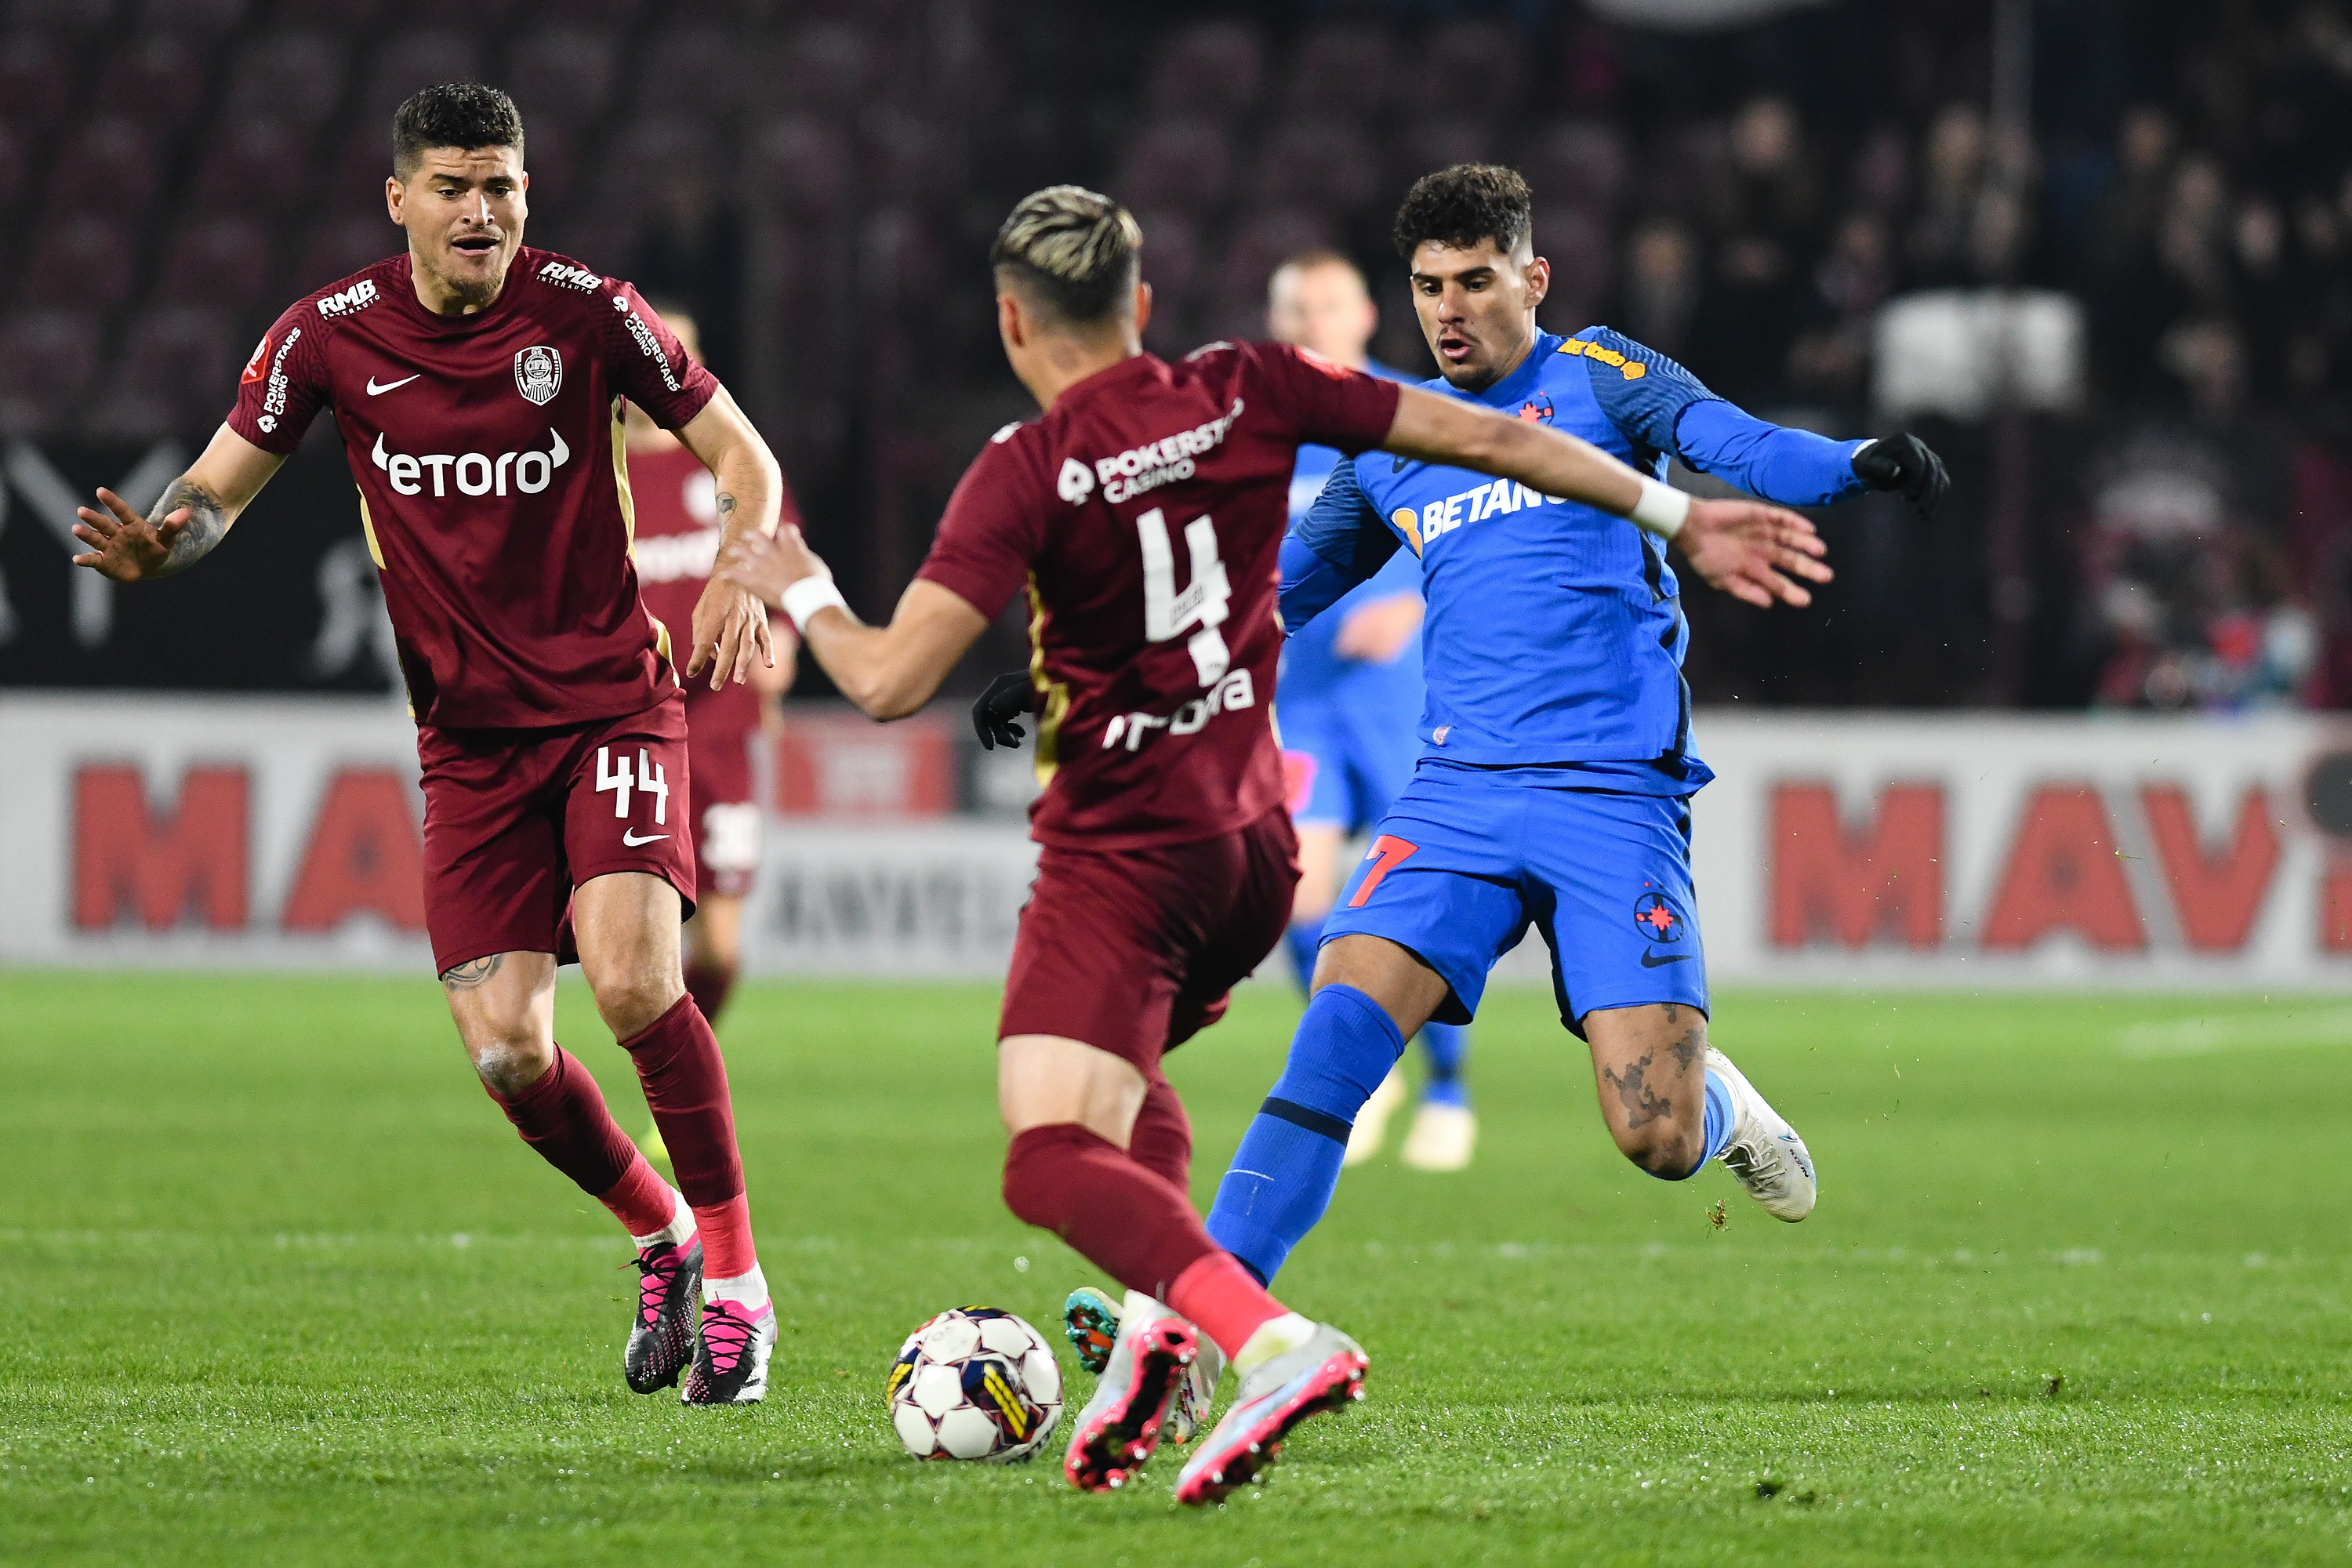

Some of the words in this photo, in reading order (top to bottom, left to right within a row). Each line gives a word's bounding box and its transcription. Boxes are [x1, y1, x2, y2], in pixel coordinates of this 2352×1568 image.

[317, 279, 376, 315] RMB
[536, 274, 593, 295] INTERAUTO
[539, 261, 603, 289] RMB
[624, 318, 652, 357] CASINO
[629, 311, 681, 392] POKERSTARS
[263, 326, 302, 412] POKERSTARS
[274, 375, 289, 416] CASNO
[1136, 506, 1232, 688] 4
[596, 746, 669, 826] 44
[1348, 834, 1420, 908] 7
